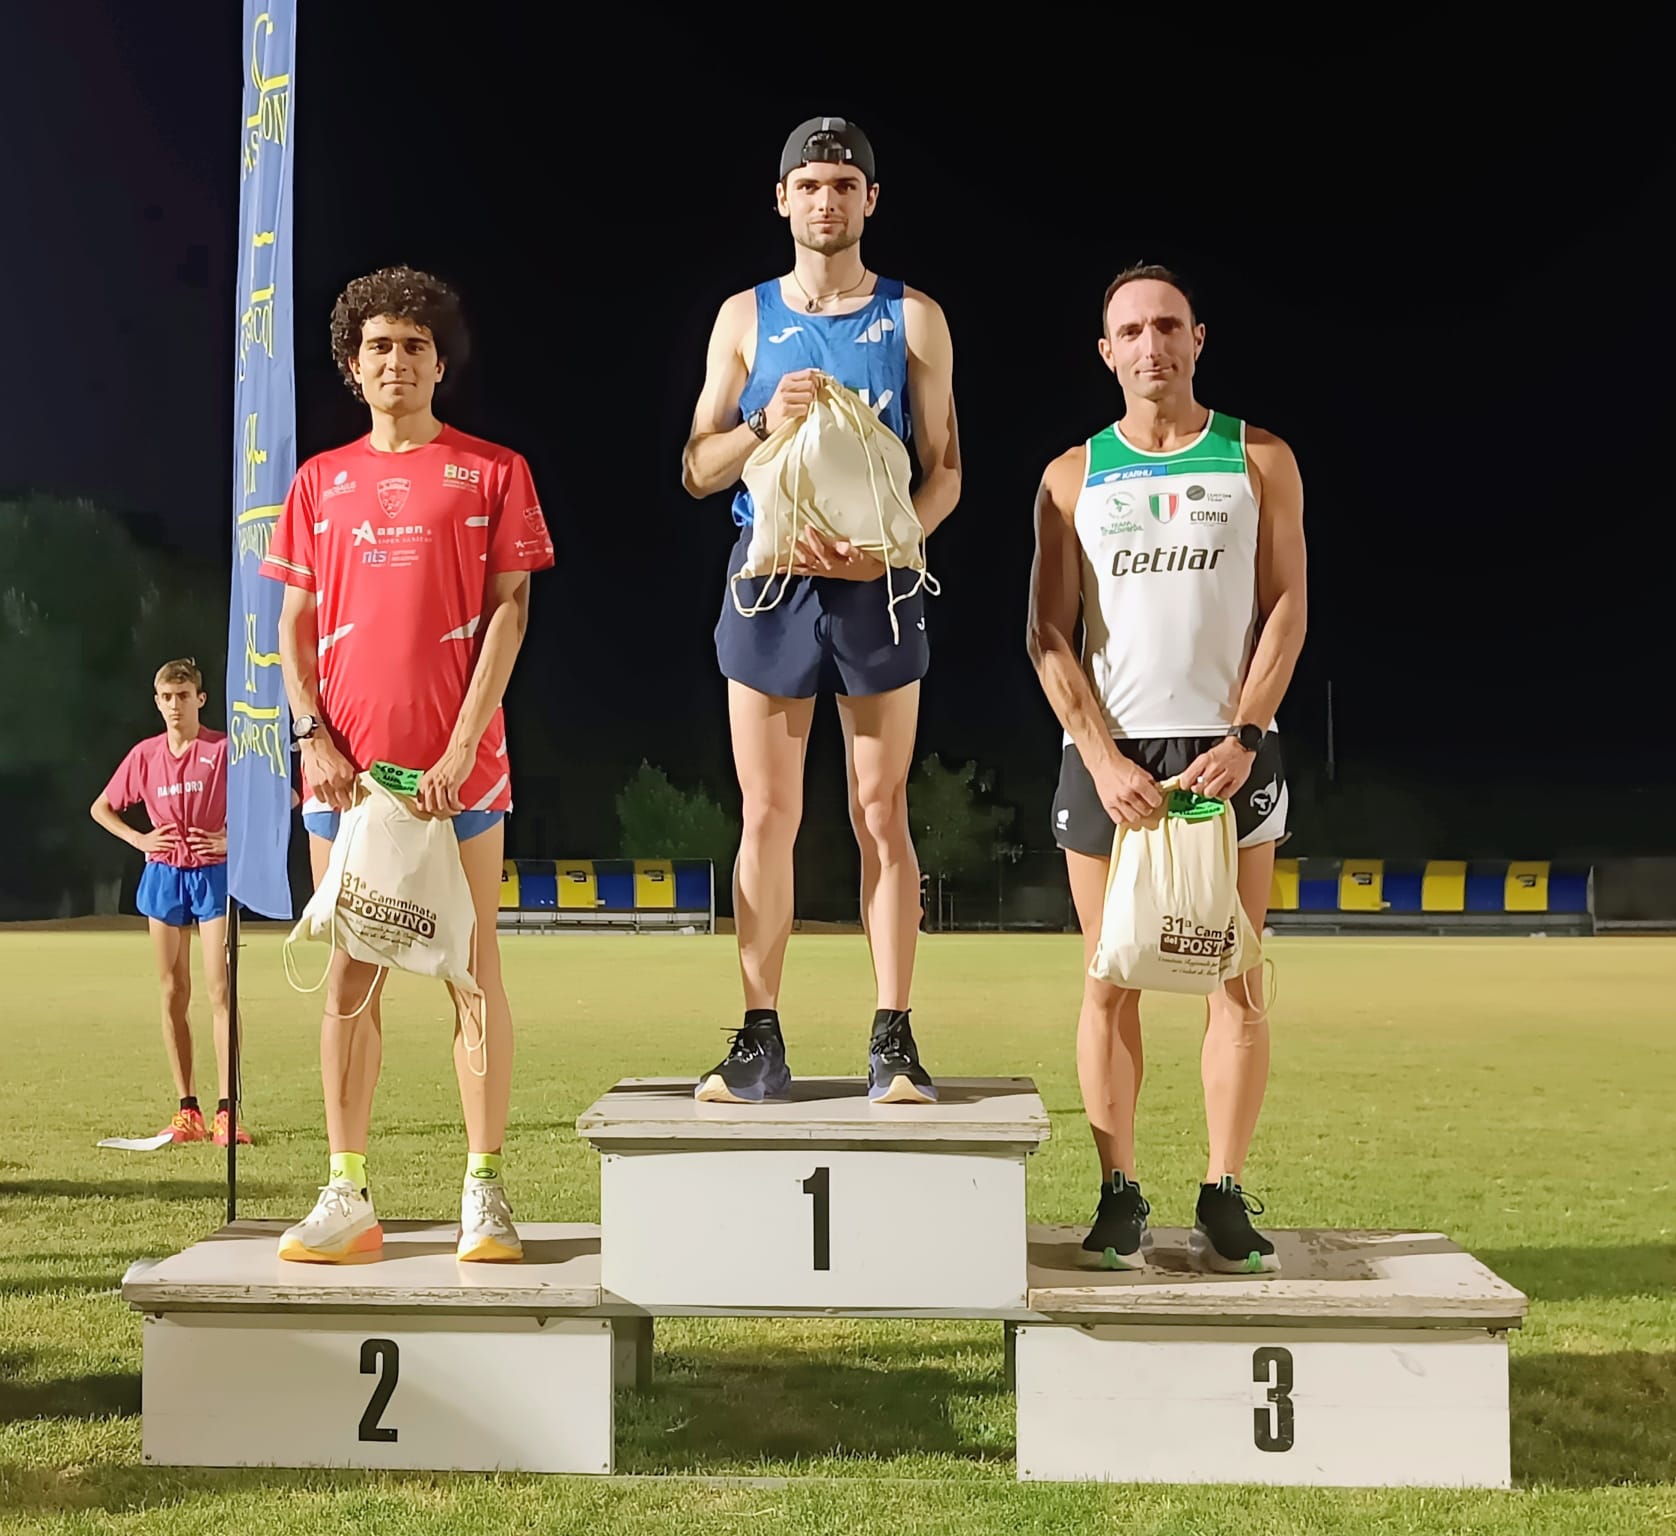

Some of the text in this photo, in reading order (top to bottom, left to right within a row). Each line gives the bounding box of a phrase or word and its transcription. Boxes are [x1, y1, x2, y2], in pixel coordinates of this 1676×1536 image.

[1112, 545, 1224, 577] Cetilar
[350, 896, 432, 935] POSTINO
[369, 890, 437, 920] Camminata
[1164, 936, 1178, 945] del
[802, 1166, 830, 1271] 1
[358, 1338, 400, 1443] 2
[1252, 1346, 1295, 1452] 3
